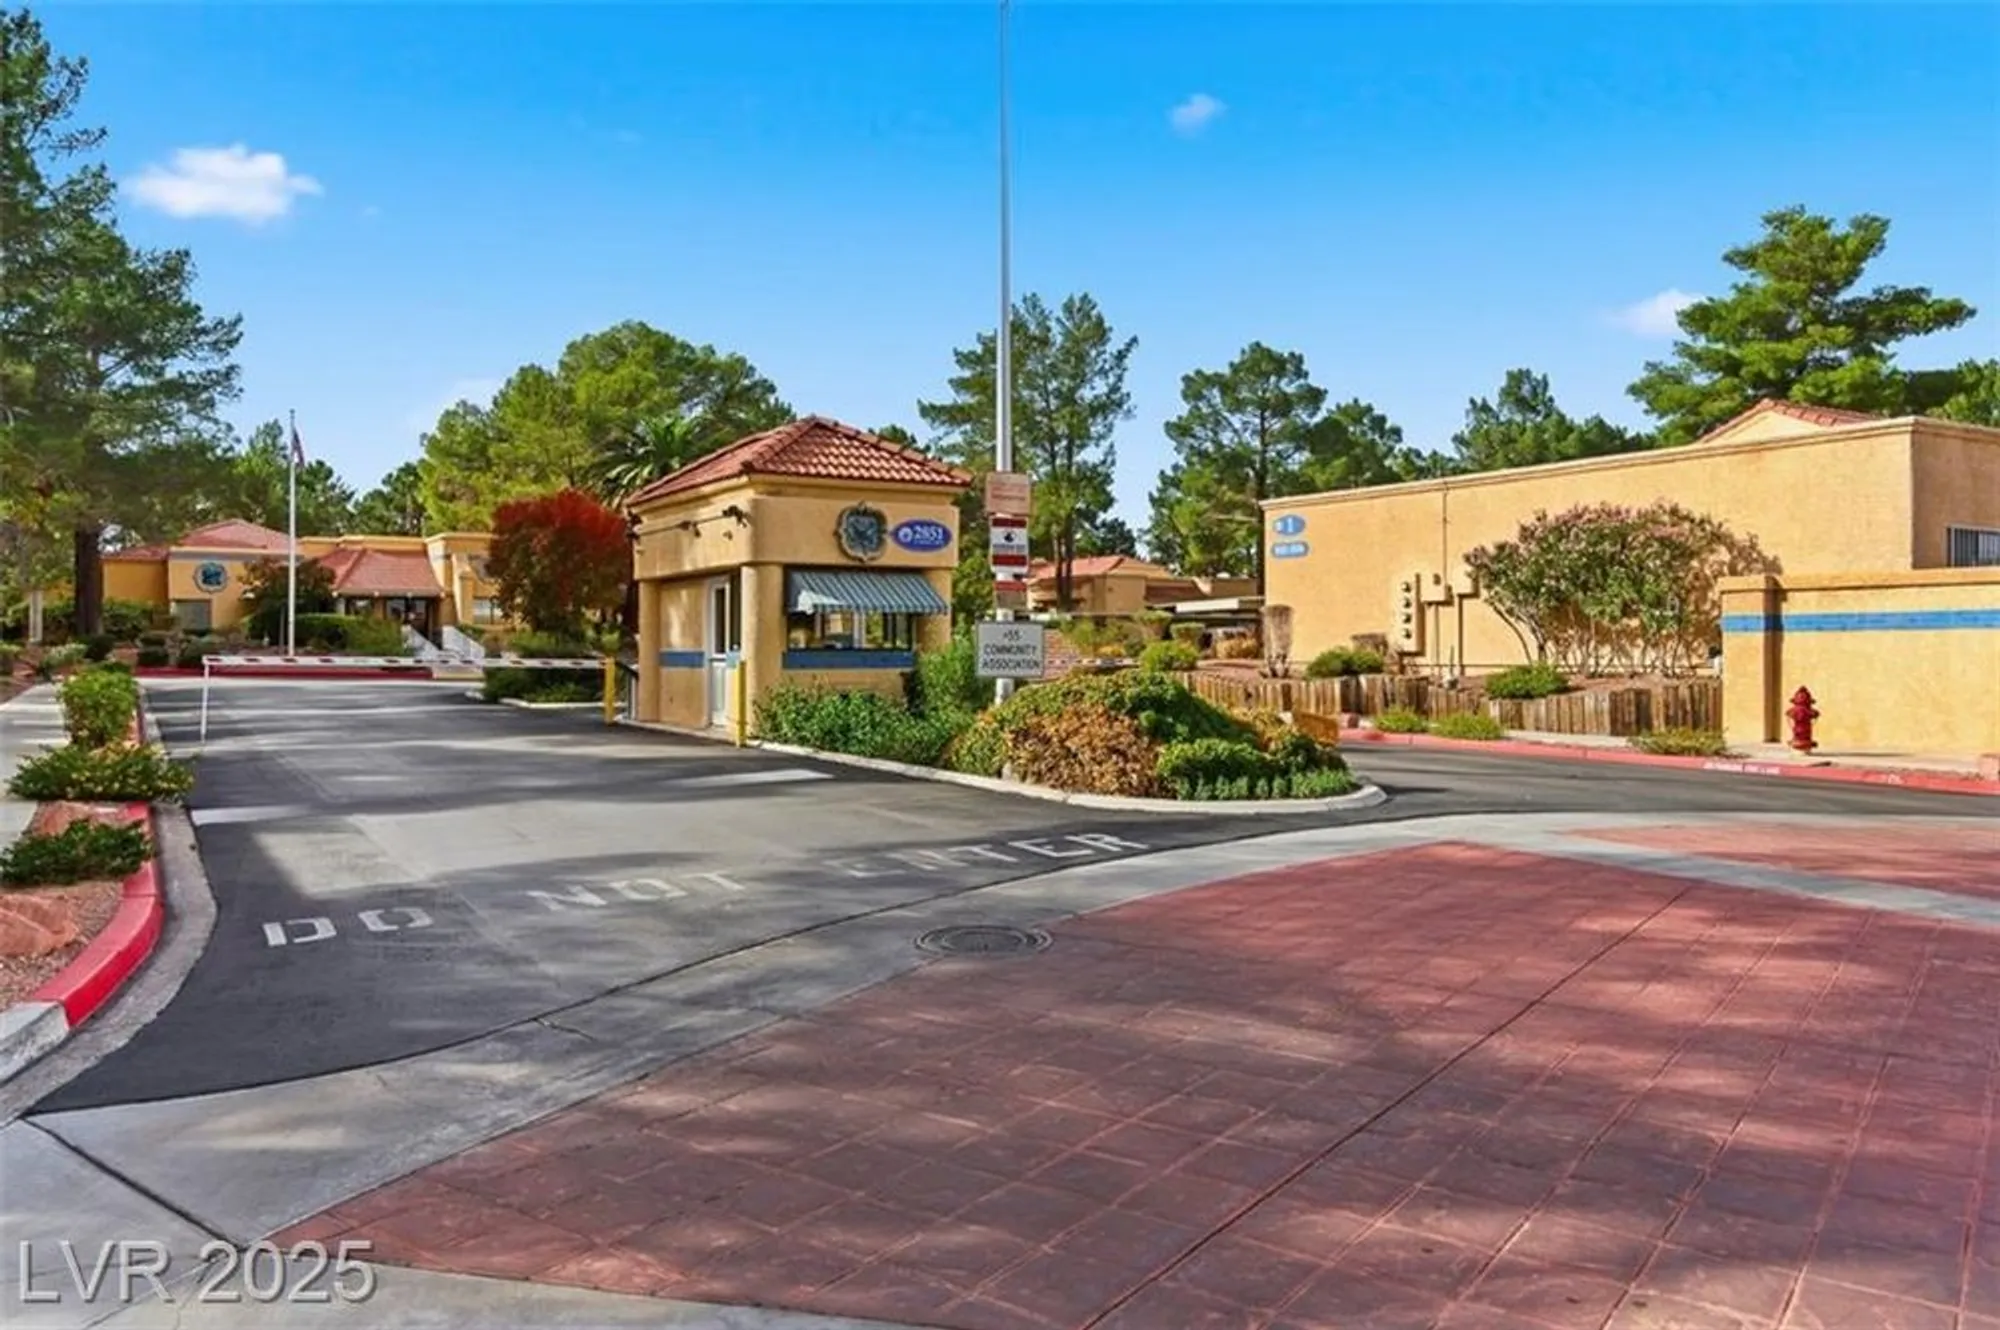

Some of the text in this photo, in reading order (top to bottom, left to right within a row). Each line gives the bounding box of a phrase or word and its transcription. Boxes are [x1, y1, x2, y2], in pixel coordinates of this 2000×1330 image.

[983, 643, 1037, 656] COMMUNITY
[982, 658, 1040, 671] ASSOCIATION
[262, 833, 1149, 946] DO NOT ENTER
